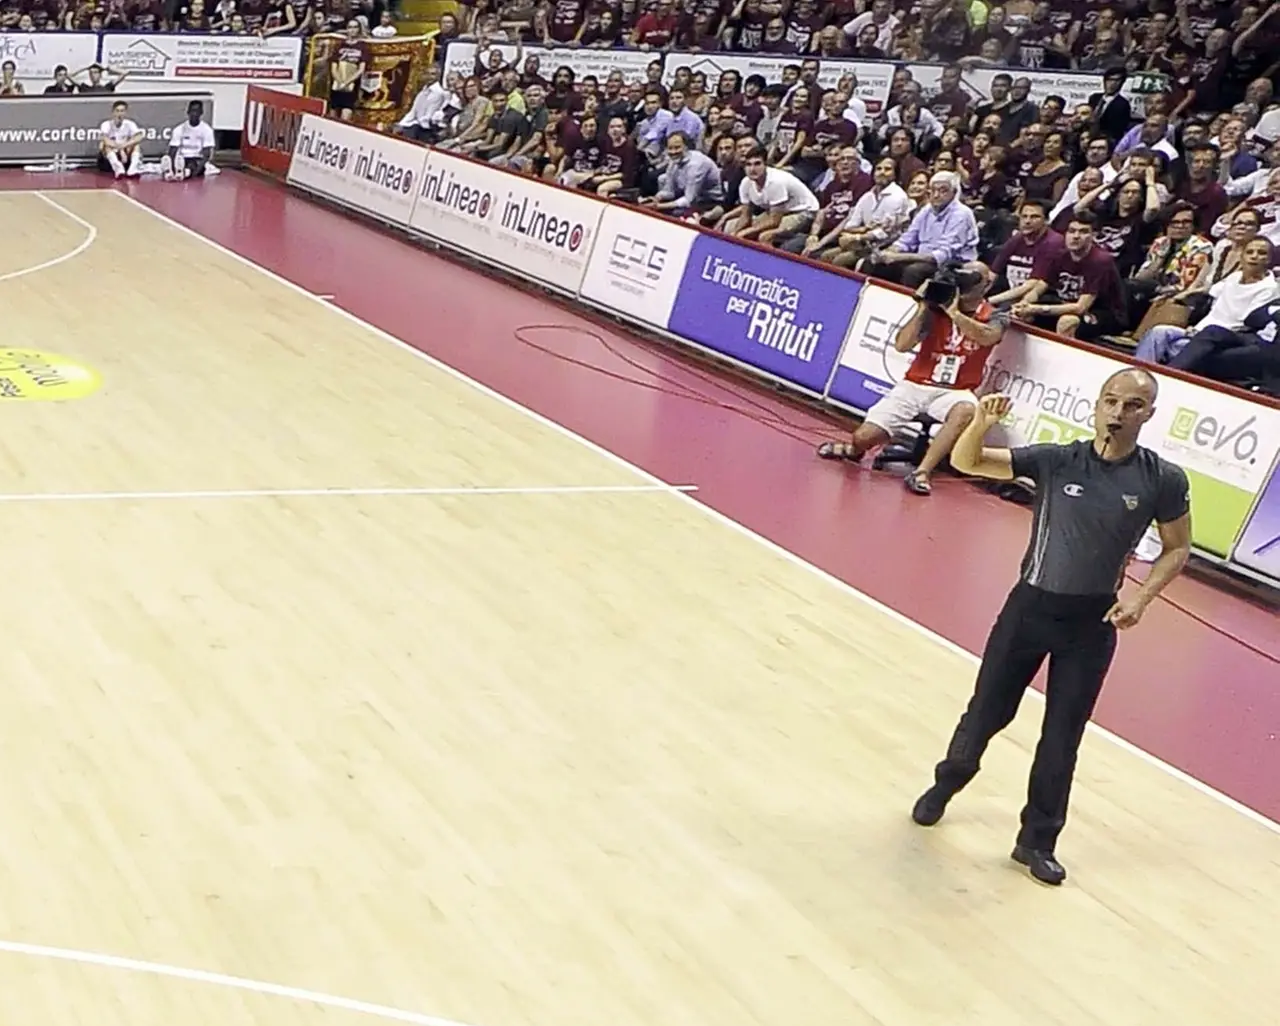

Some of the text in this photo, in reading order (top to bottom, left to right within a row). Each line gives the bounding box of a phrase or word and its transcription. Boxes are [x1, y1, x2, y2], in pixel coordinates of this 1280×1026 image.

[354, 146, 401, 190] inLinea
[421, 165, 478, 218] inLinea
[501, 191, 570, 248] inLinea
[702, 255, 800, 310] L'informatica
[747, 303, 823, 363] Rifiuti
